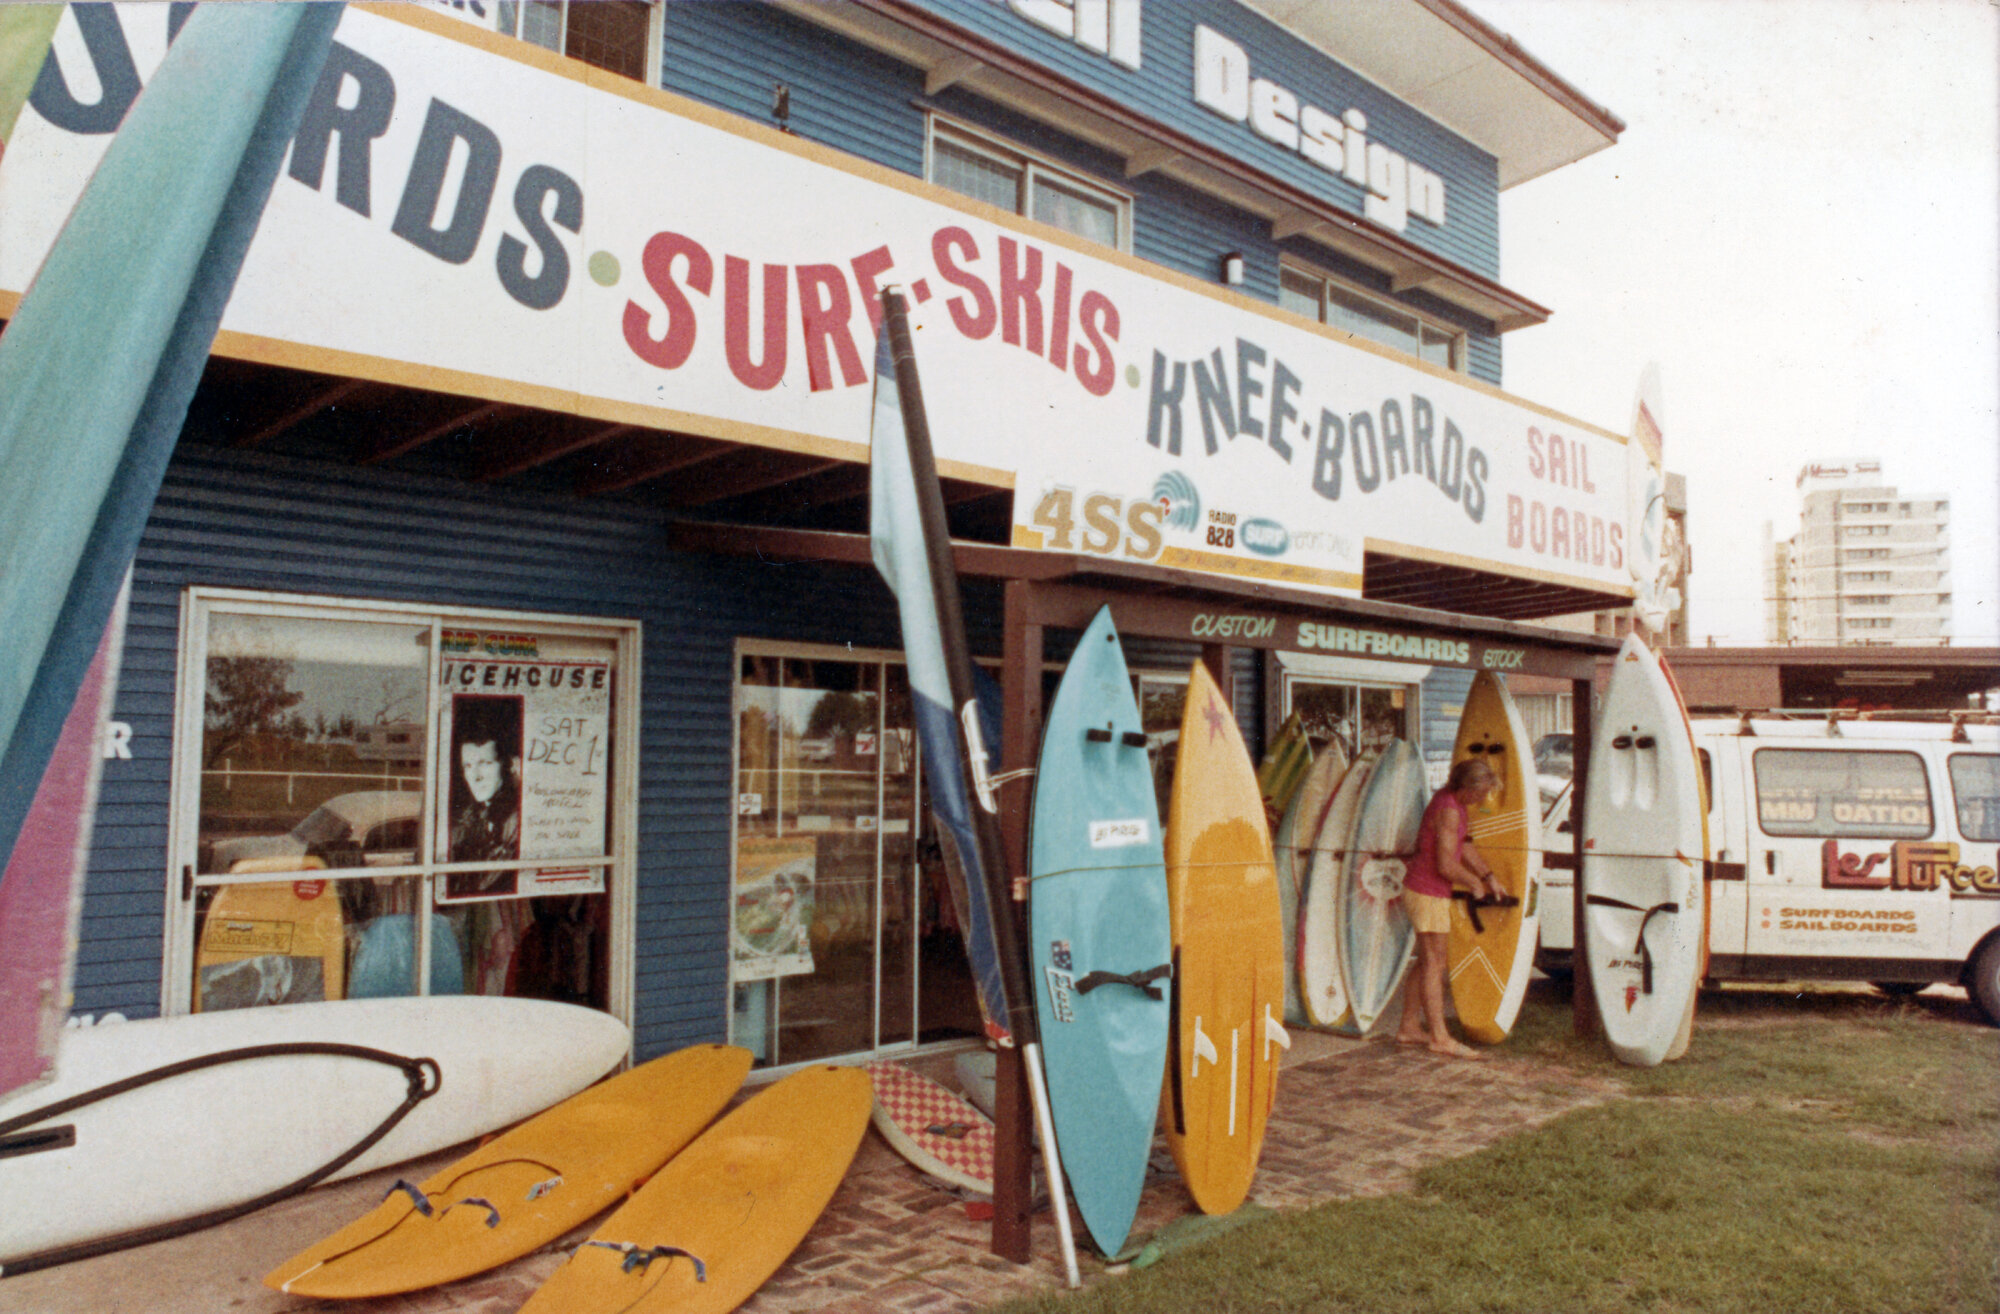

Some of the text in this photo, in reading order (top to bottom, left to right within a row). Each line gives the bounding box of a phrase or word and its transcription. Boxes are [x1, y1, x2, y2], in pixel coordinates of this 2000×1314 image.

[1194, 24, 1445, 233] Design
[1528, 425, 1596, 494] SAIL
[1033, 488, 1164, 560] 4SS
[1208, 509, 1237, 527] RADIO
[1506, 494, 1623, 570] BOARDS
[1206, 525, 1235, 548] 828
[1191, 613, 1276, 638] CUSTOM
[1297, 621, 1470, 664] SURFBOARDS
[541, 717, 588, 738] SAT
[527, 738, 576, 766] DEC
[1779, 907, 1916, 921] SURFBOARDS
[1779, 920, 1918, 933] SAILBOARDS
